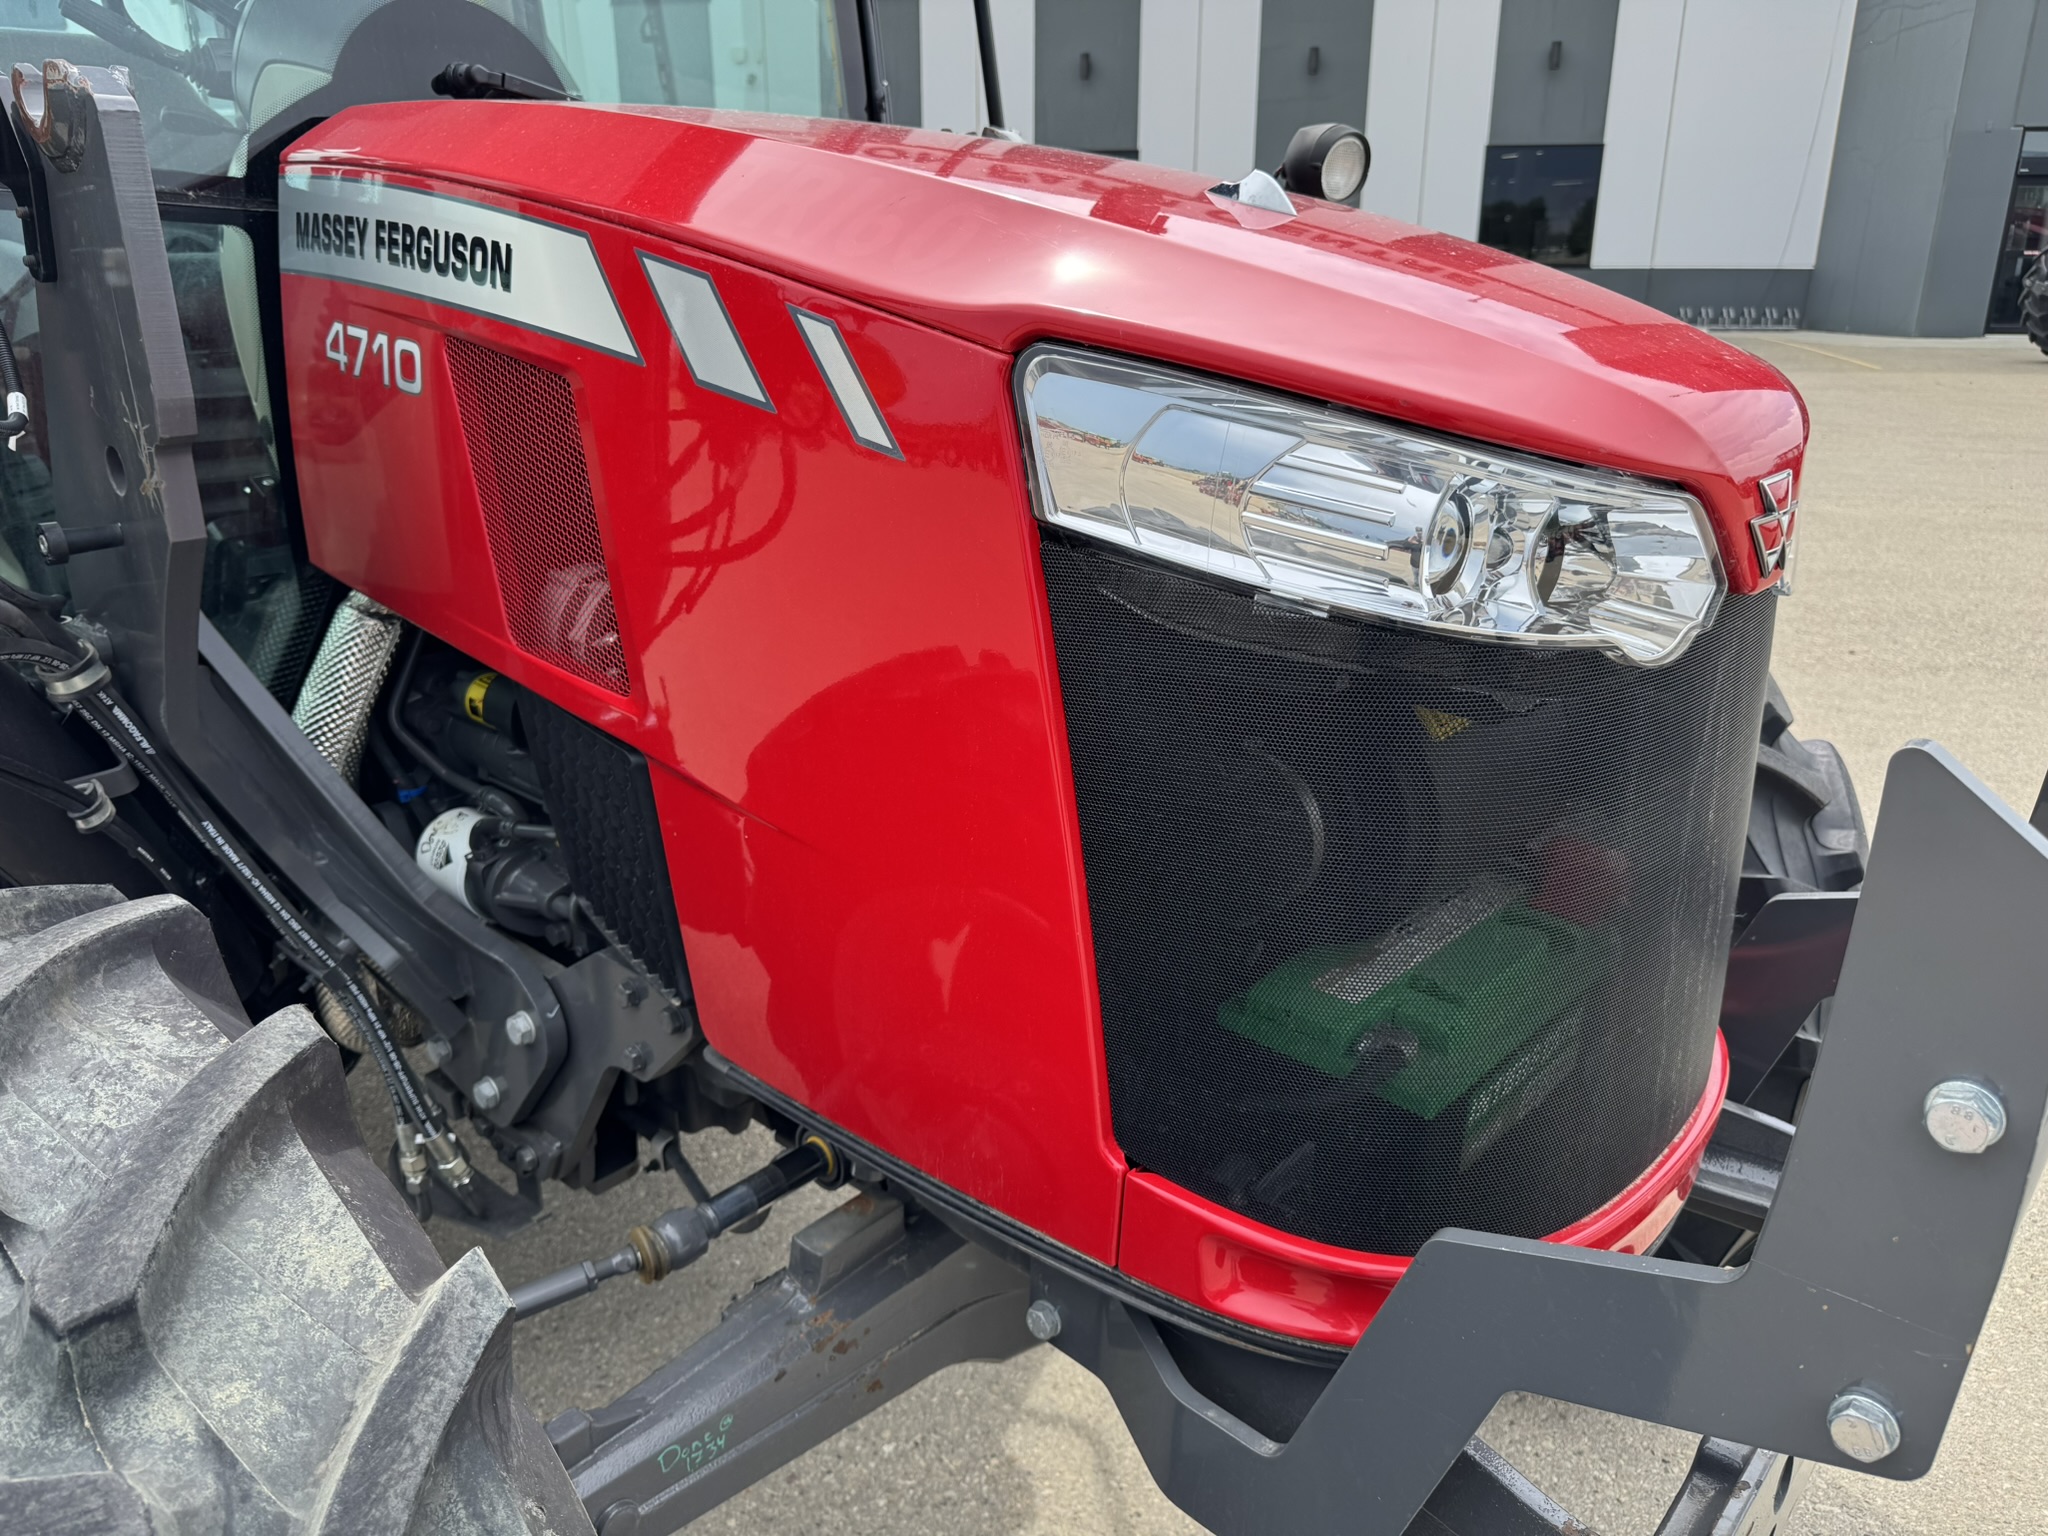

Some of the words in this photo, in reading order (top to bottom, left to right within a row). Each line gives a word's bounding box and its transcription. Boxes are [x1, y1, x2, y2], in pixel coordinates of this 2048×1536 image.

[296, 212, 368, 260] MASSEY
[375, 218, 513, 293] FERGUSON
[325, 320, 422, 395] 4710
[96, 690, 113, 706] AT4K
[91, 719, 102, 729] DN
[110, 705, 150, 750] ALFAGOMMA
[200, 819, 218, 838] ITALY
[215, 836, 224, 845] IN
[221, 843, 239, 863] MADE
[256, 885, 276, 904] MSHA
[279, 909, 290, 920] DN
[307, 938, 318, 949] EN
[687, 1433, 726, 1473] 1734
